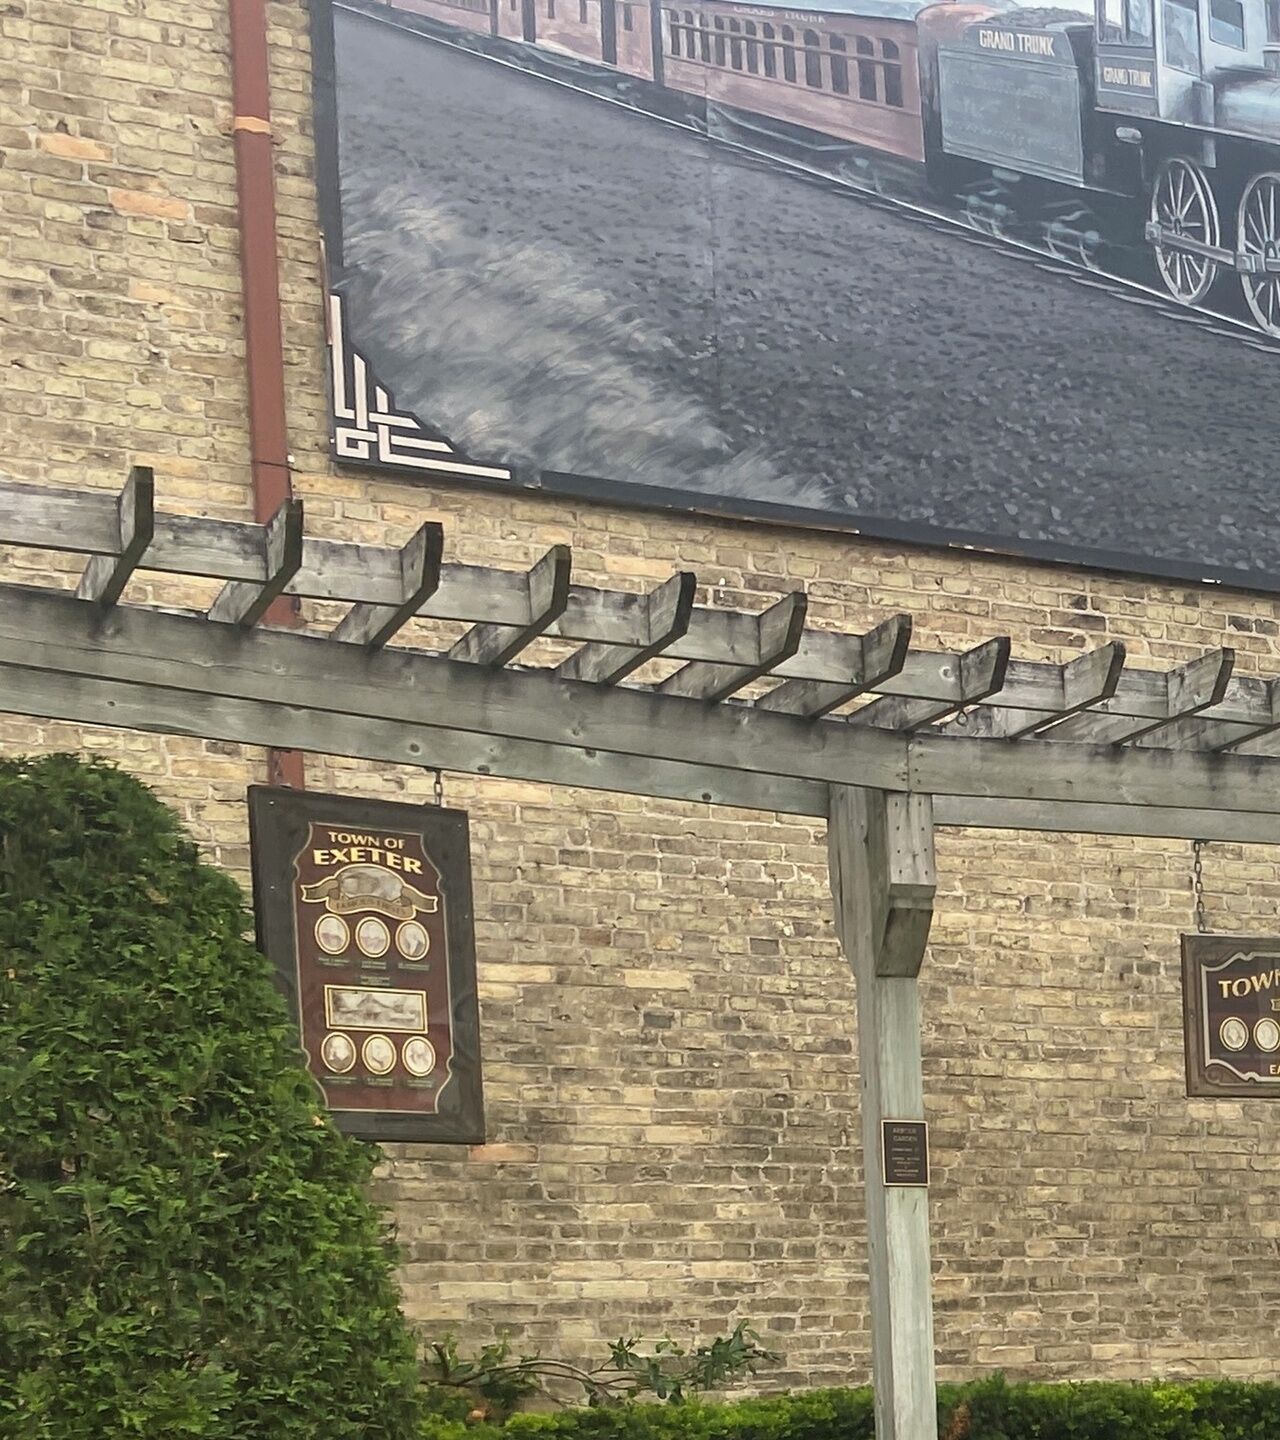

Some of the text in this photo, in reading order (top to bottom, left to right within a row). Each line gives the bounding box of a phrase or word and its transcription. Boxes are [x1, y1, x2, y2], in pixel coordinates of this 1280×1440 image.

[979, 30, 1056, 57] GRAND TRUNK
[1103, 67, 1152, 88] GRAND TRUNK
[327, 831, 406, 849] TOWN OF
[313, 846, 423, 875] EXETER
